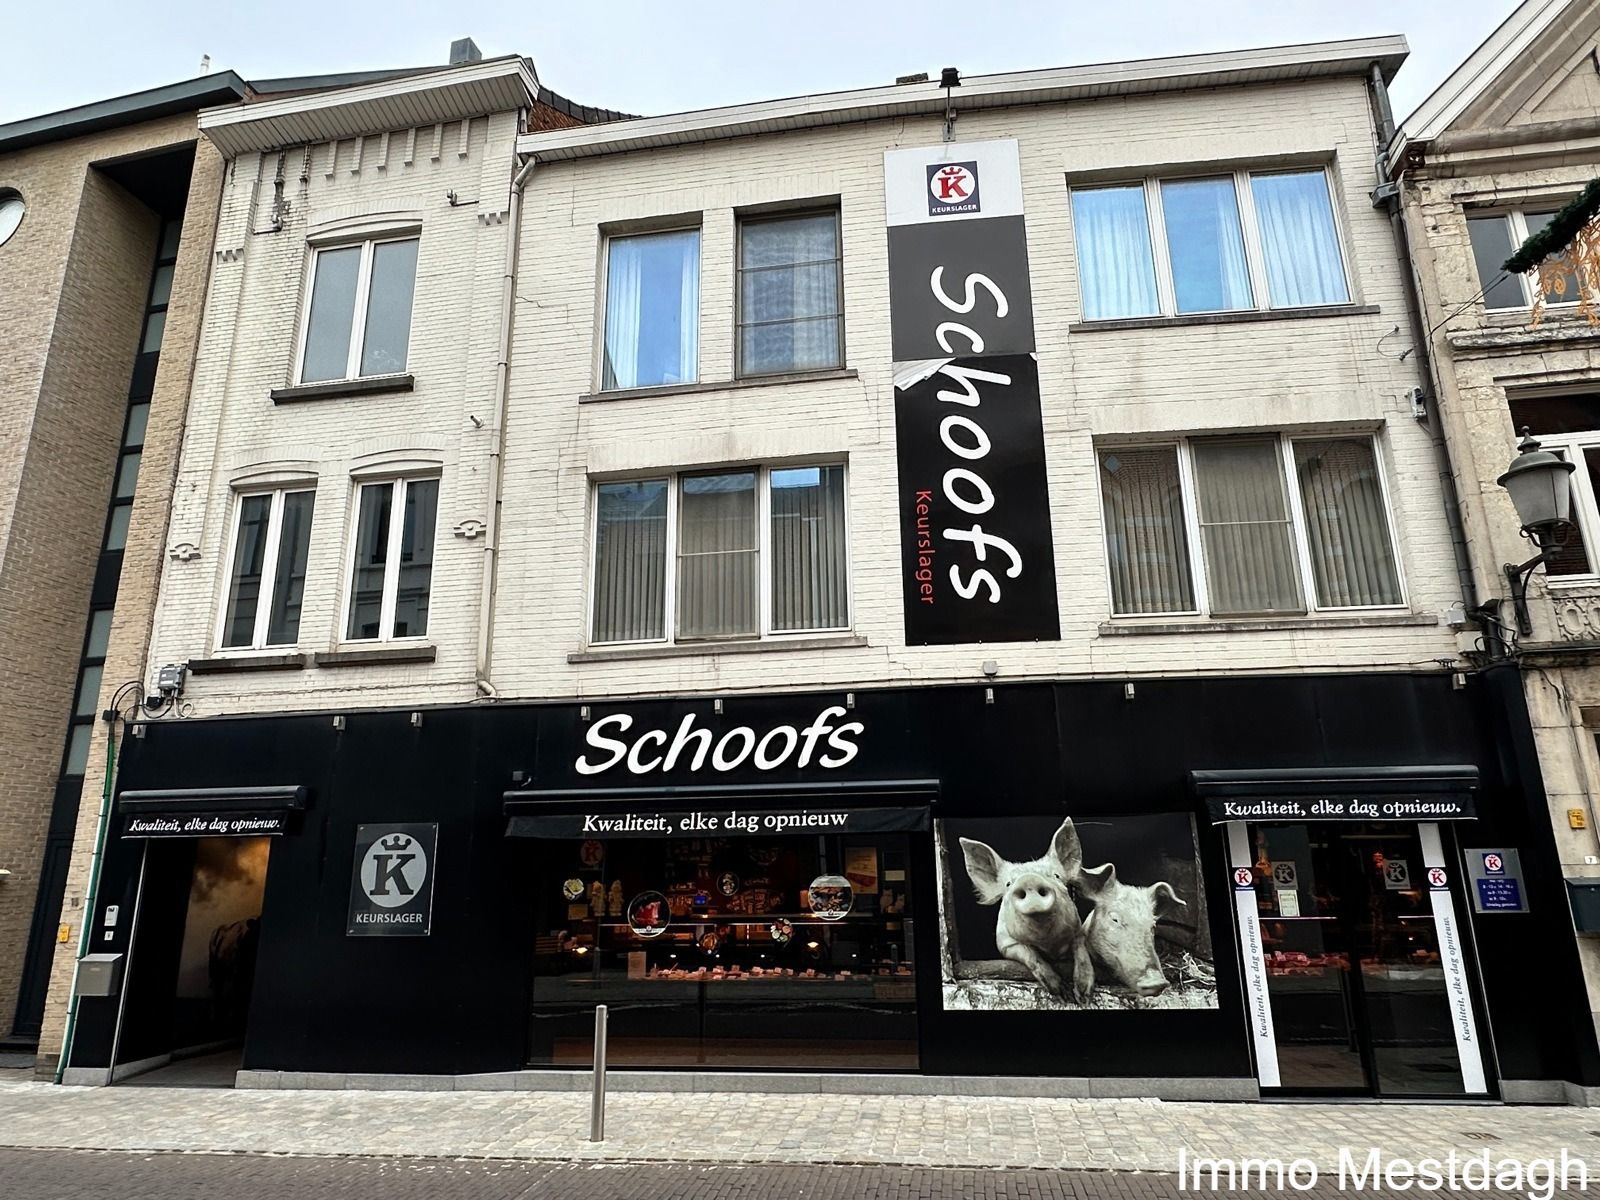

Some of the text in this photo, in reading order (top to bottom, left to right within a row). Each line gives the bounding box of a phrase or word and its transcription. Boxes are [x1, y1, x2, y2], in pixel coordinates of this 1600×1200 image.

[937, 175, 969, 199] K
[932, 204, 978, 214] KEURSLAGER
[930, 265, 1023, 604] Schoofs
[916, 490, 936, 605] Keurslager
[575, 705, 865, 775] Schoofs
[1224, 799, 1462, 817] Kwaliteit, elke dag opnieuw.
[129, 817, 281, 833] Kwaliteit, elke dag opnieuw.
[582, 810, 849, 834] Kwaliteit, elke dag opnieuw
[369, 853, 416, 896] K
[356, 913, 423, 923] KEURSLAGER
[1251, 956, 1260, 972] dag
[1450, 958, 1460, 975] dag
[1253, 974, 1262, 992] elke
[1453, 976, 1462, 995] elke
